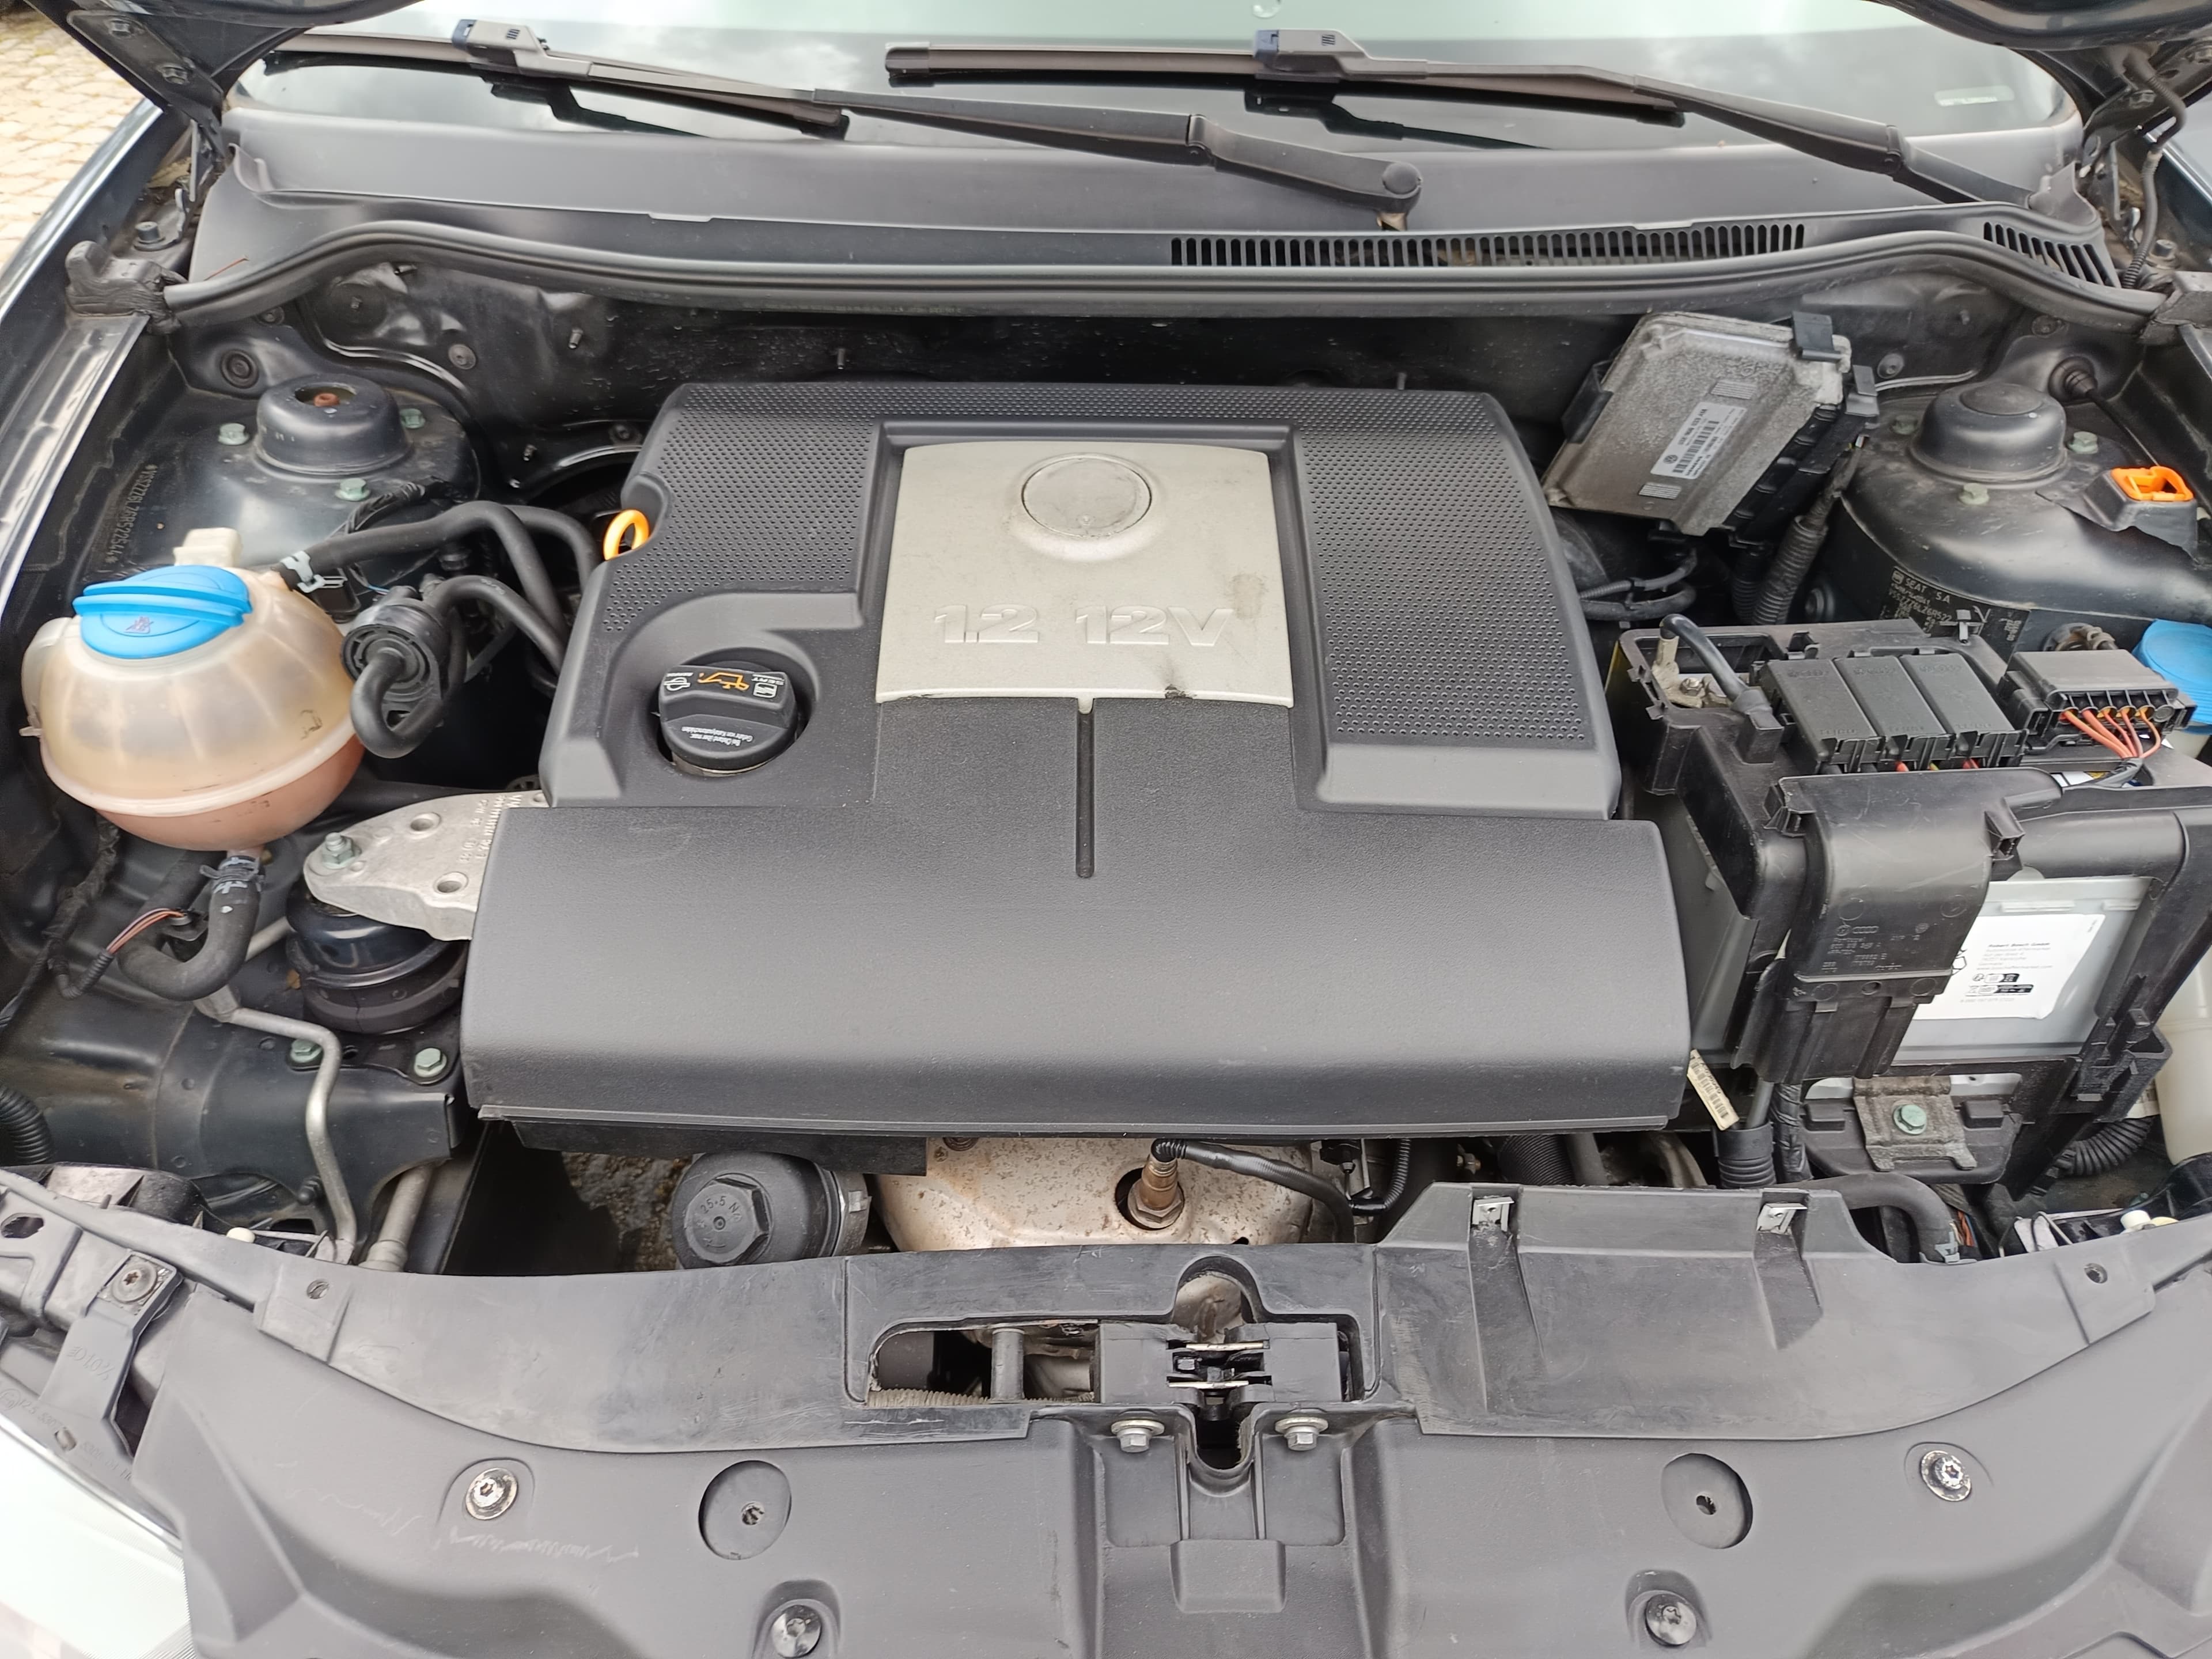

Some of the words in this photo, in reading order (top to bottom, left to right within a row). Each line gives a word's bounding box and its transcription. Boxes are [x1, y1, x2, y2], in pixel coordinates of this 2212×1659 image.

[1905, 578, 1927, 593] SEAT
[1074, 605, 1234, 646] 12V
[751, 676, 785, 686] SEAT
